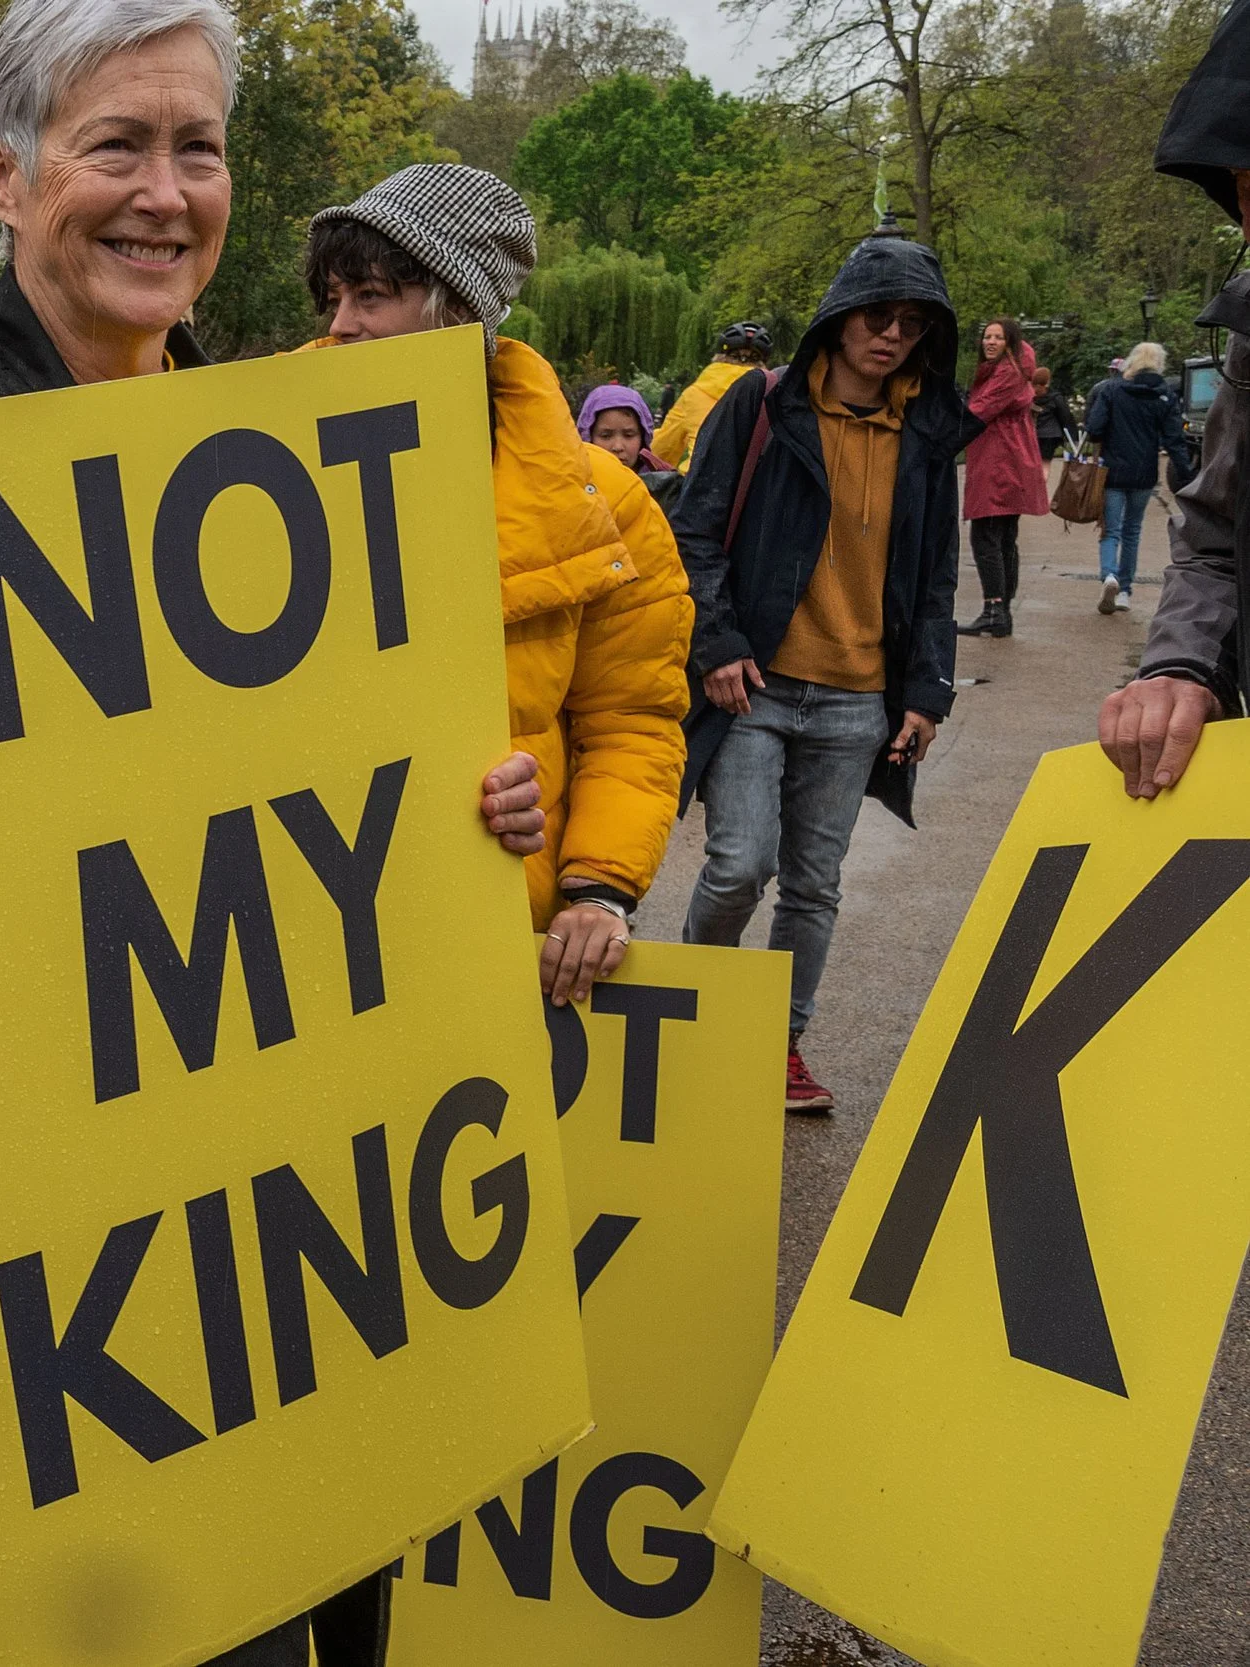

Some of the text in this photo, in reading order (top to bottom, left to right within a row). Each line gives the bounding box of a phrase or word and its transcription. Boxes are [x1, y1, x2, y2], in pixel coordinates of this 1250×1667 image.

[77, 757, 411, 1105] MY
[850, 838, 1250, 1400] K
[393, 1452, 716, 1619] NG
